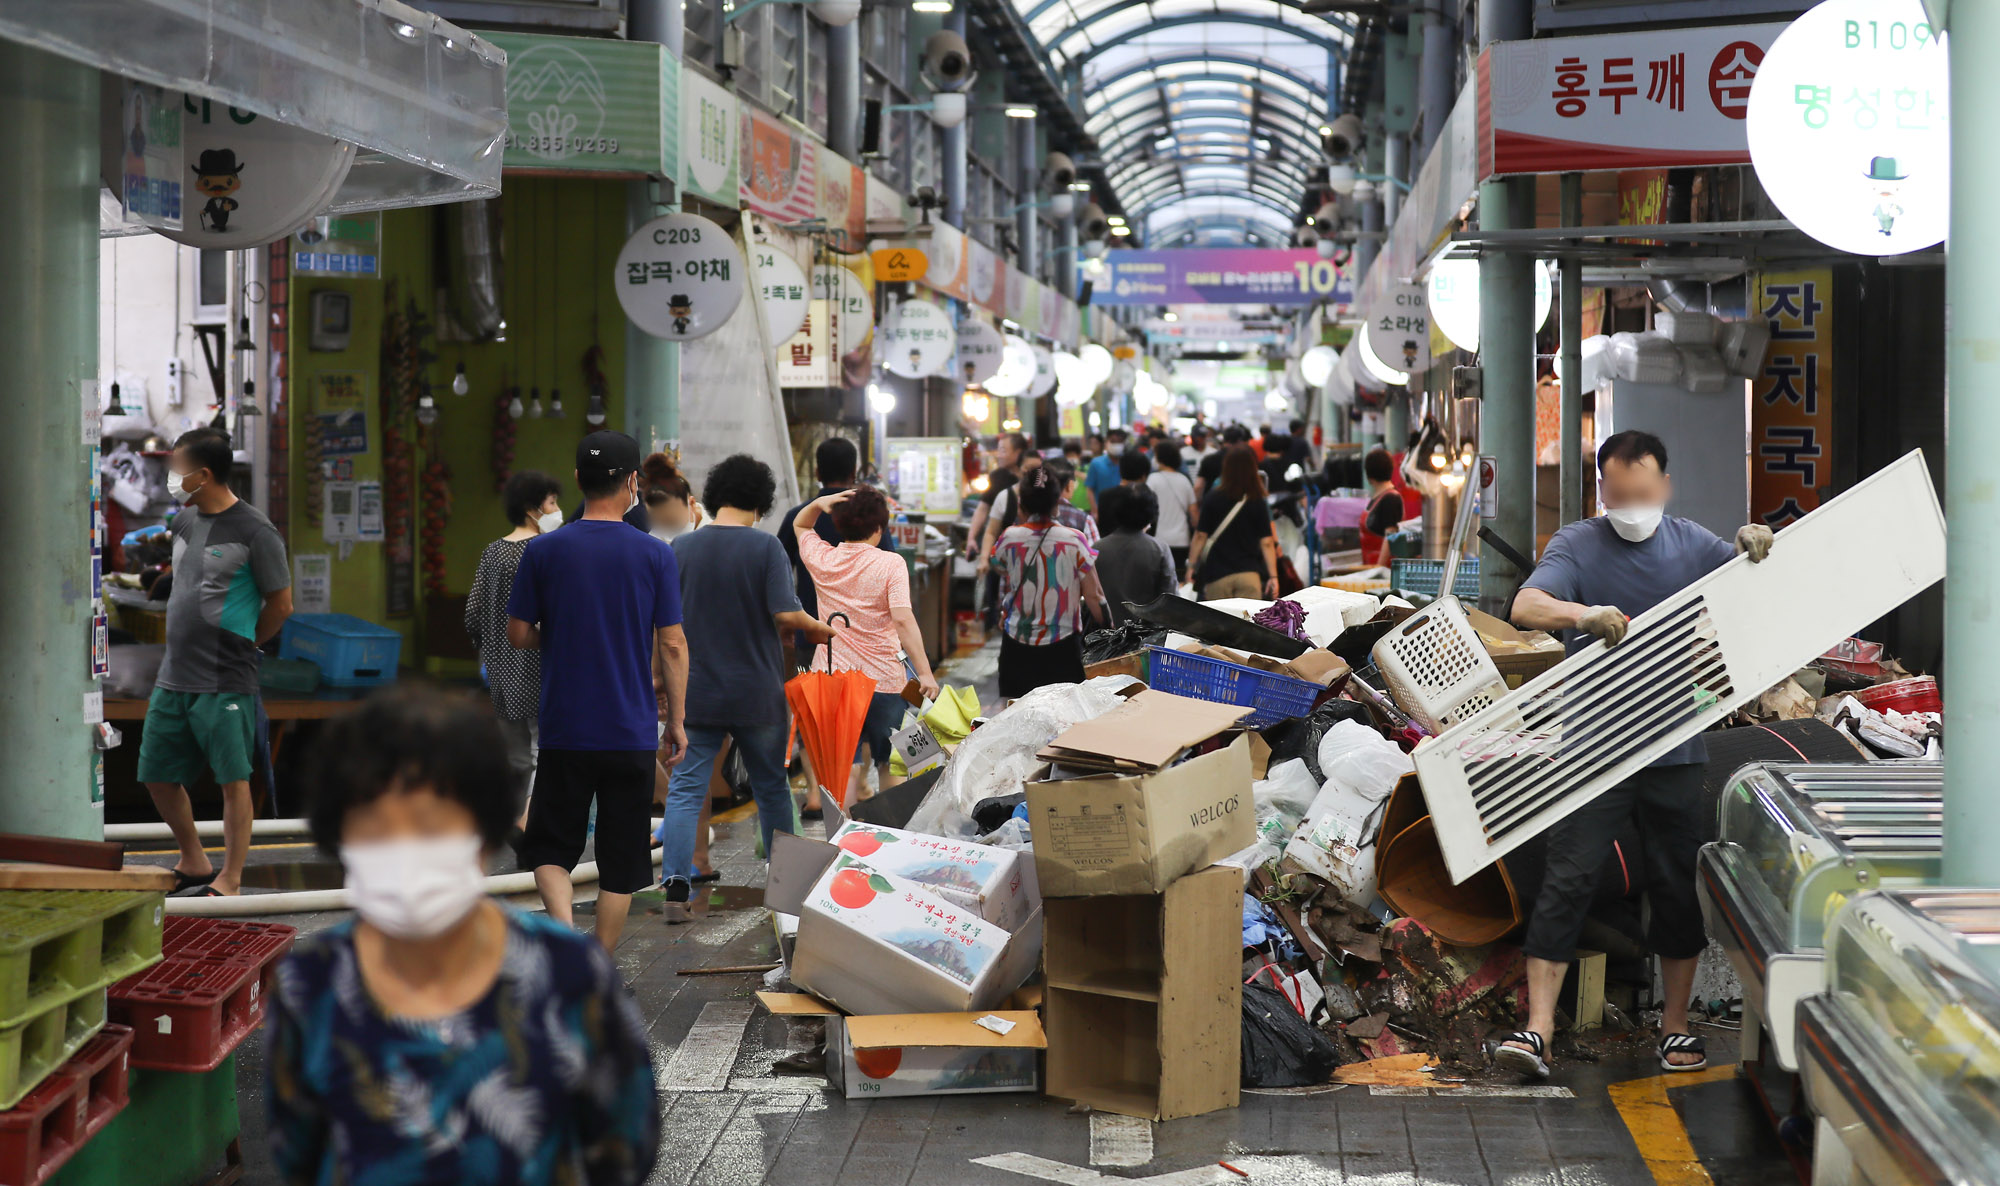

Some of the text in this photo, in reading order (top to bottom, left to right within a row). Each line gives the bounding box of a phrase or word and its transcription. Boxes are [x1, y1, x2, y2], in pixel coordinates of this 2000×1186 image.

[1844, 19, 1931, 50] B109
[1552, 52, 1685, 118] 홍두깨
[1794, 84, 1949, 130] 명성한
[653, 228, 701, 245] C203
[627, 258, 730, 285] 잡곡·야채
[1396, 294, 1424, 307] C10
[819, 899, 840, 915] 10kg
[858, 1082, 881, 1092] 10kg
